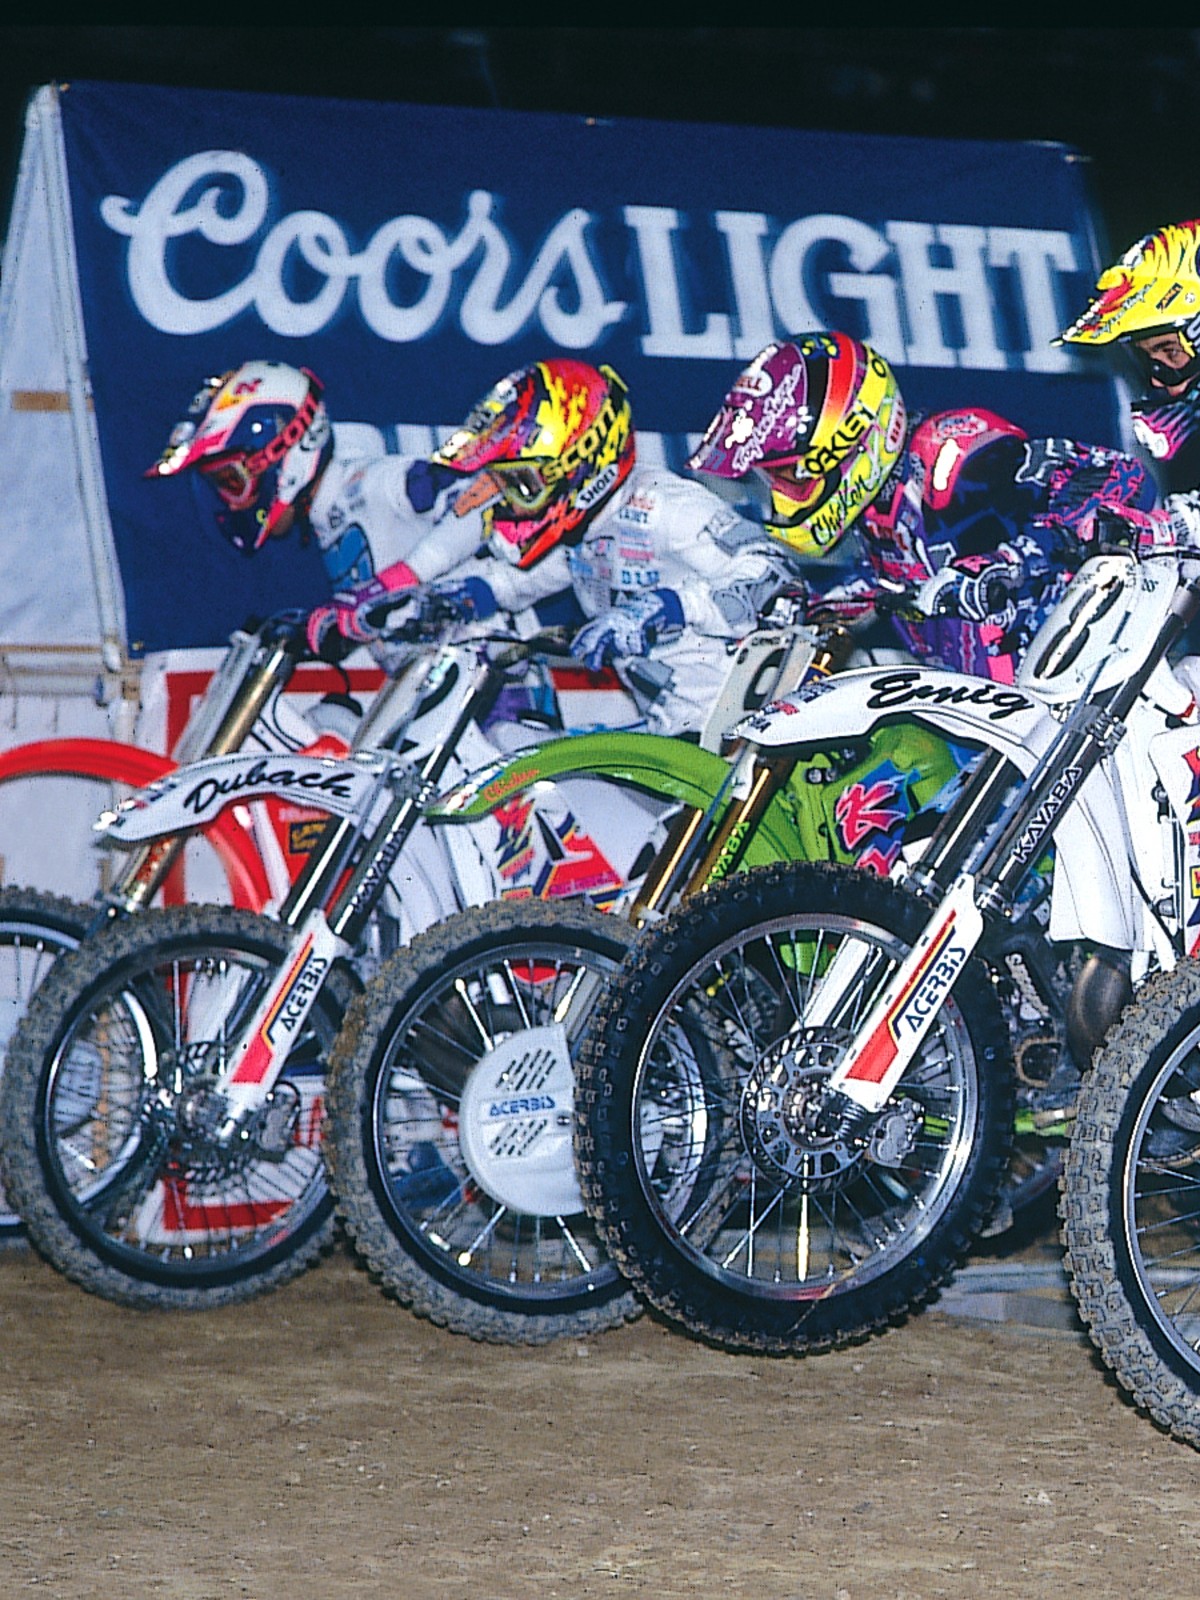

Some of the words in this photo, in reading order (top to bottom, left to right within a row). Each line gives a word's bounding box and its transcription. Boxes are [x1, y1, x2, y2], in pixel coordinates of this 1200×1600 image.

[101, 150, 626, 345] Coors
[623, 205, 1078, 374] LIGHT
[543, 398, 615, 484] SCOTT
[805, 401, 874, 475] OAKLEY
[1034, 575, 1126, 682] 8
[866, 671, 1047, 722] Emig
[184, 760, 356, 814] Dubach
[1012, 766, 1083, 865] KAYABA
[281, 957, 328, 1033] ACERBIS
[903, 947, 967, 1034] ACERBIS
[489, 1096, 556, 1117] ACERBIS
